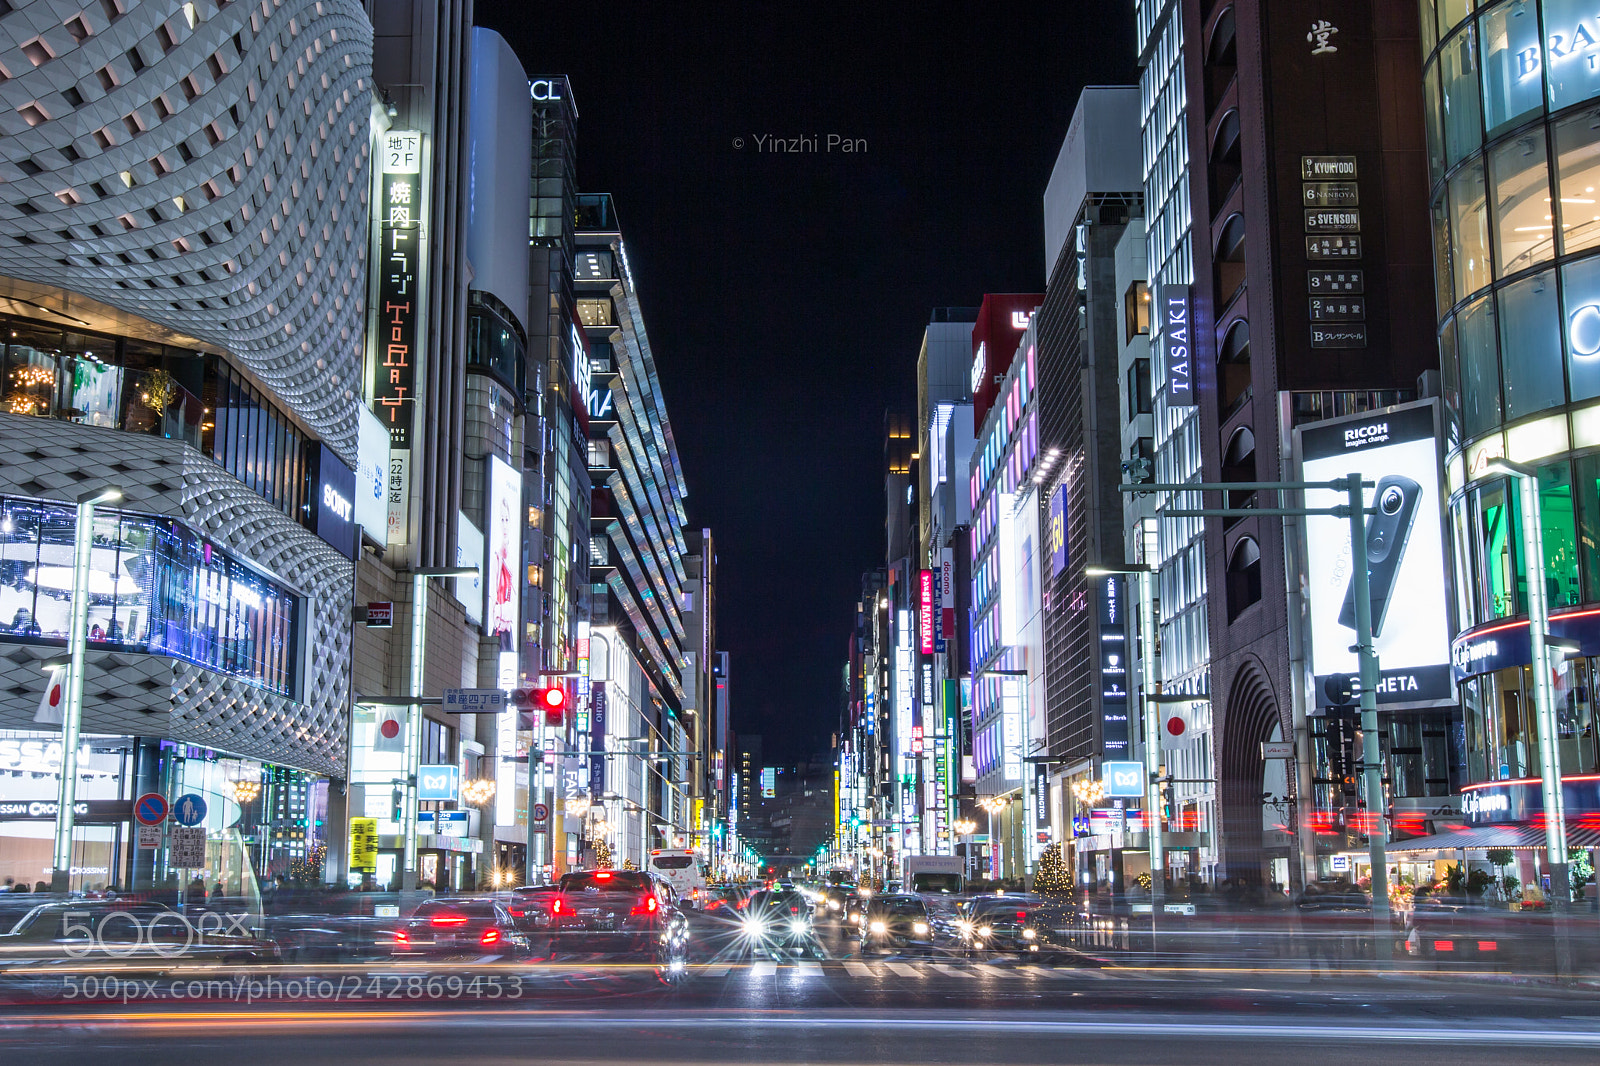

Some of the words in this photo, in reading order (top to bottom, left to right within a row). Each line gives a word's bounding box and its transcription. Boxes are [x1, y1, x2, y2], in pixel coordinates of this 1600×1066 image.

[1307, 20, 1338, 54] 堂
[1516, 15, 1600, 79] BRA
[528, 80, 561, 100] CL
[388, 136, 417, 151] 地下
[1314, 162, 1354, 174] KYUKYODO
[1306, 189, 1315, 200] 6
[1308, 216, 1317, 226] 5
[1317, 213, 1357, 225] SVENSON
[1310, 243, 1319, 253] 4
[1311, 277, 1320, 287] 3
[1313, 300, 1321, 309] 2
[1314, 310, 1320, 318] 1
[1313, 331, 1324, 342] B
[1169, 298, 1189, 394] TASAKI
[382, 300, 410, 422] TORAJI
[1344, 422, 1388, 441] RICOH
[323, 483, 352, 523] SONY
[1052, 509, 1064, 554] GU
[943, 561, 951, 595] docomo
[922, 605, 932, 649] NATARAJ
[1376, 675, 1419, 693] HETA
[447, 694, 500, 704] 銀座四丁目
[565, 770, 579, 819] FANL
[70, 867, 108, 875] CROSSING
